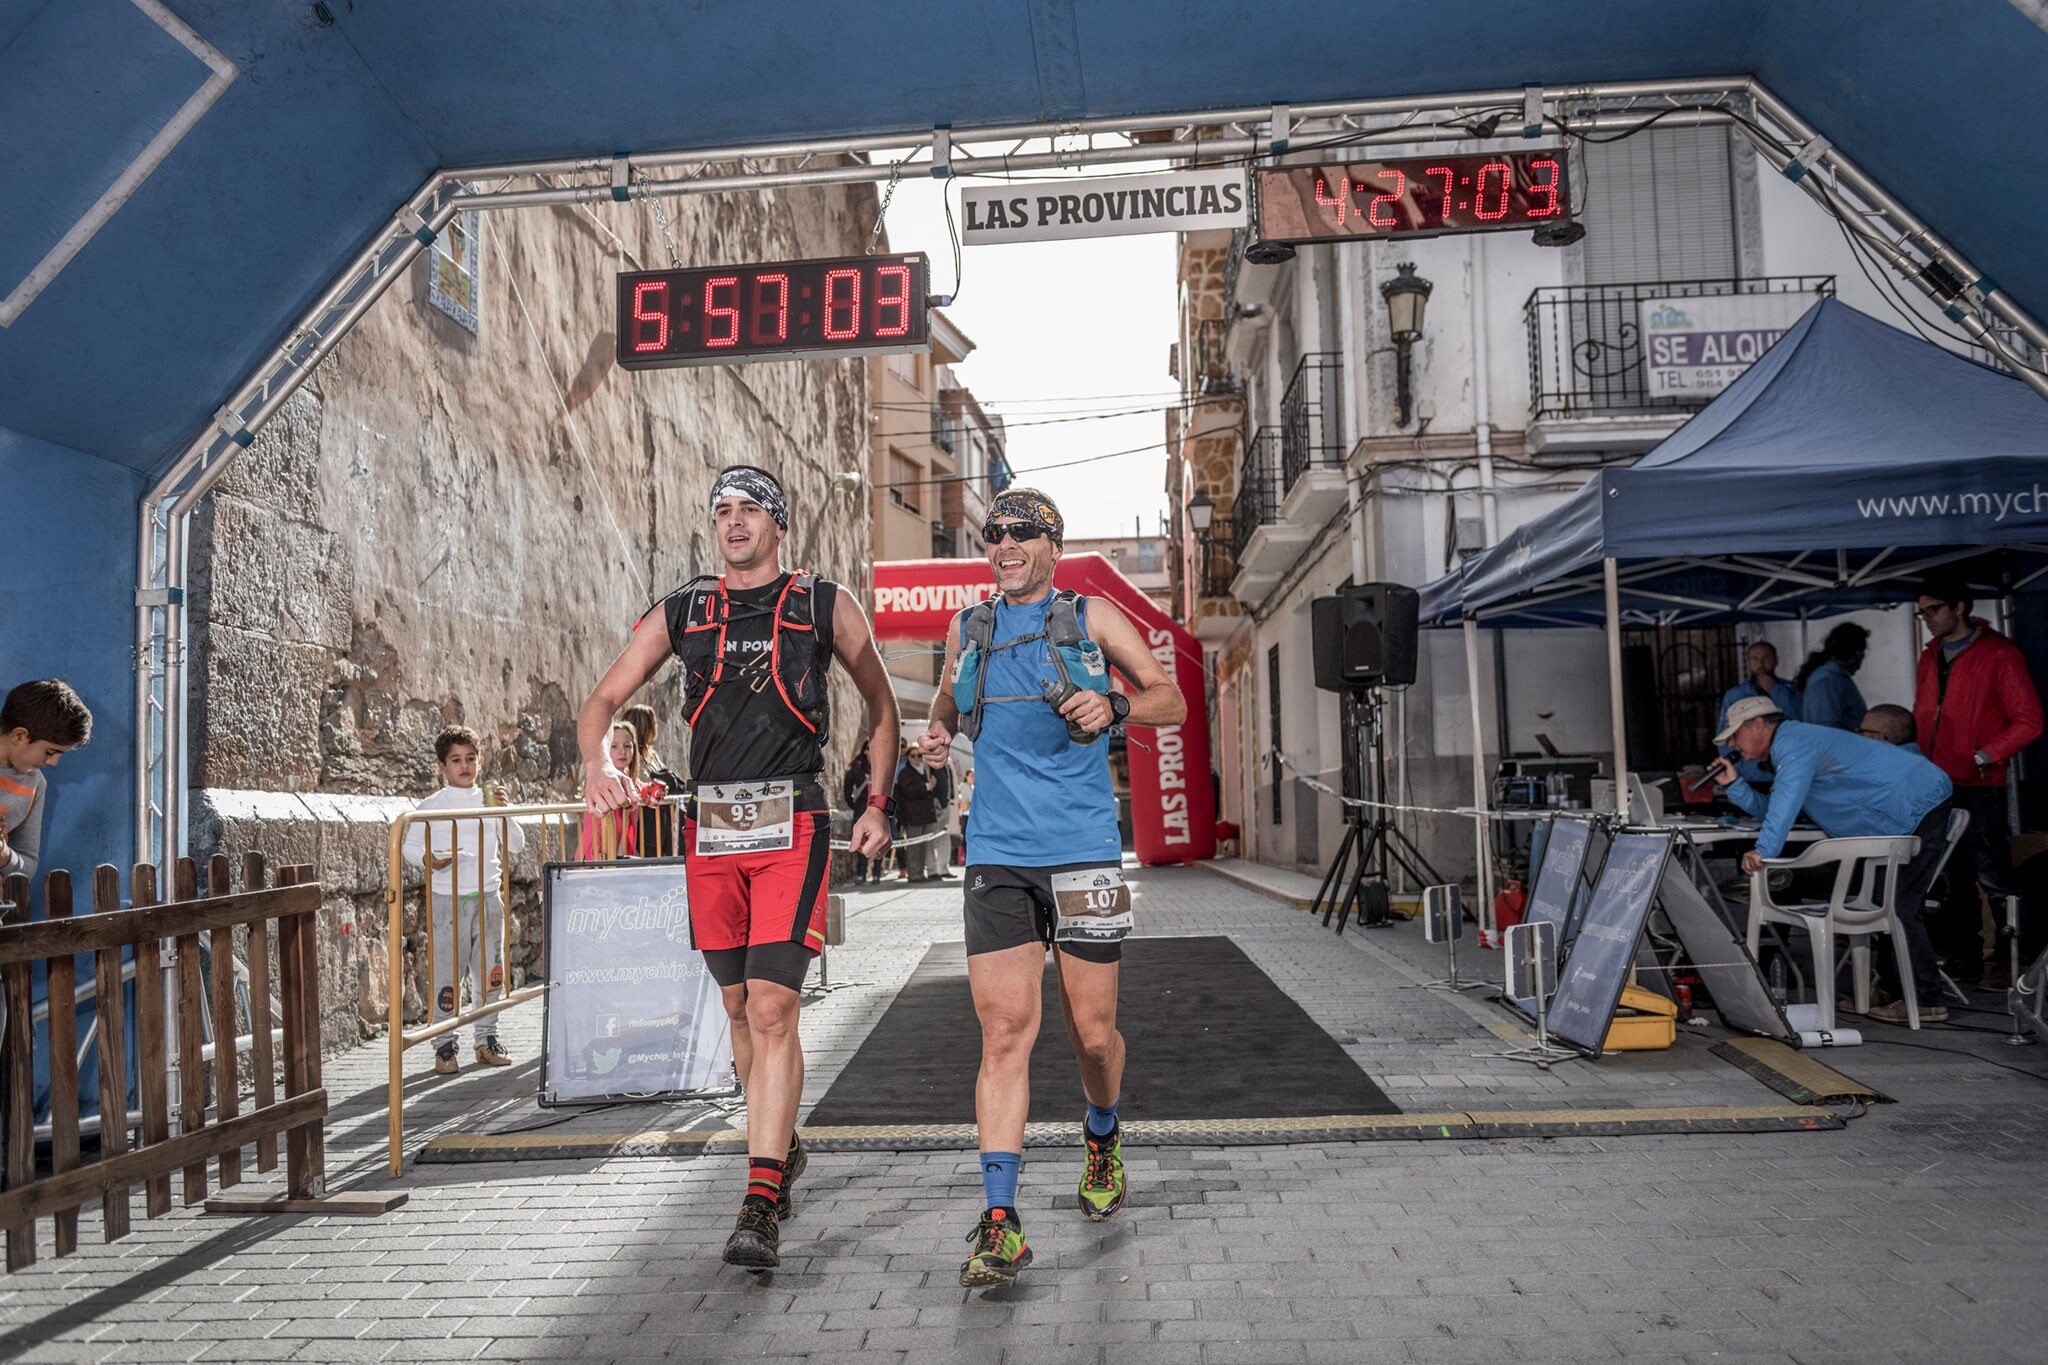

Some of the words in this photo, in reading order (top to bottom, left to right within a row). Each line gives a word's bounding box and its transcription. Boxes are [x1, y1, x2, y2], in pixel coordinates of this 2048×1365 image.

[966, 198, 1028, 231] LAS
[1037, 183, 1242, 226] PROVINCIAS
[1654, 336, 1689, 364] SE
[731, 803, 758, 822] 93
[1161, 793, 1191, 846] LAS
[1085, 889, 1119, 909] 107
[567, 896, 690, 941] mychip
